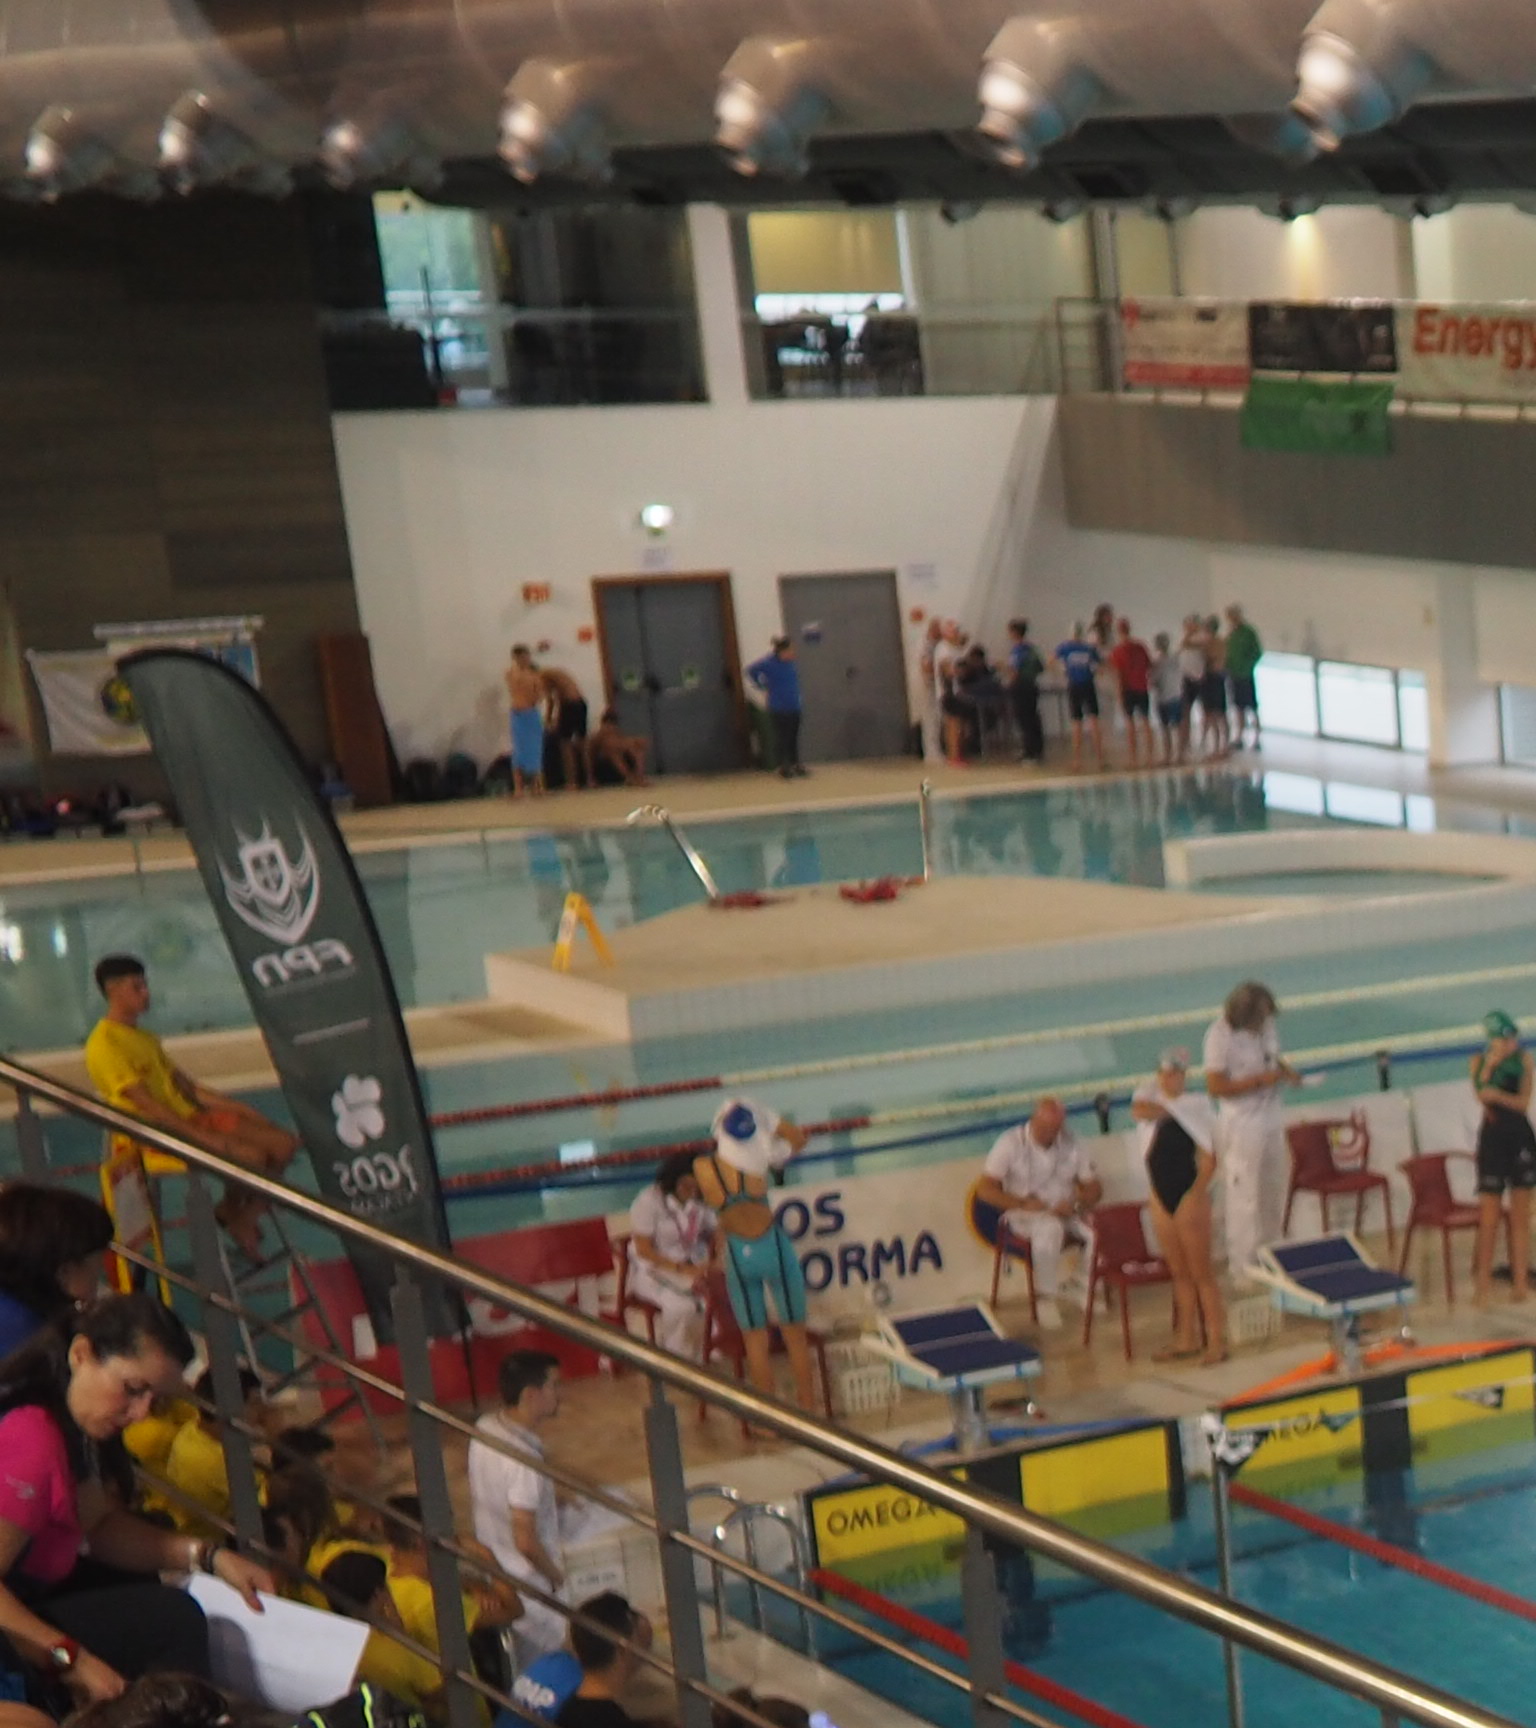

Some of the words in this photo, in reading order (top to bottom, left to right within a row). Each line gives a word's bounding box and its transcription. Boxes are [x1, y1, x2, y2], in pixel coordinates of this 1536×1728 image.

[775, 1191, 845, 1239] OS
[800, 1229, 943, 1290] ORMA
[826, 1495, 936, 1537] OMEGA
